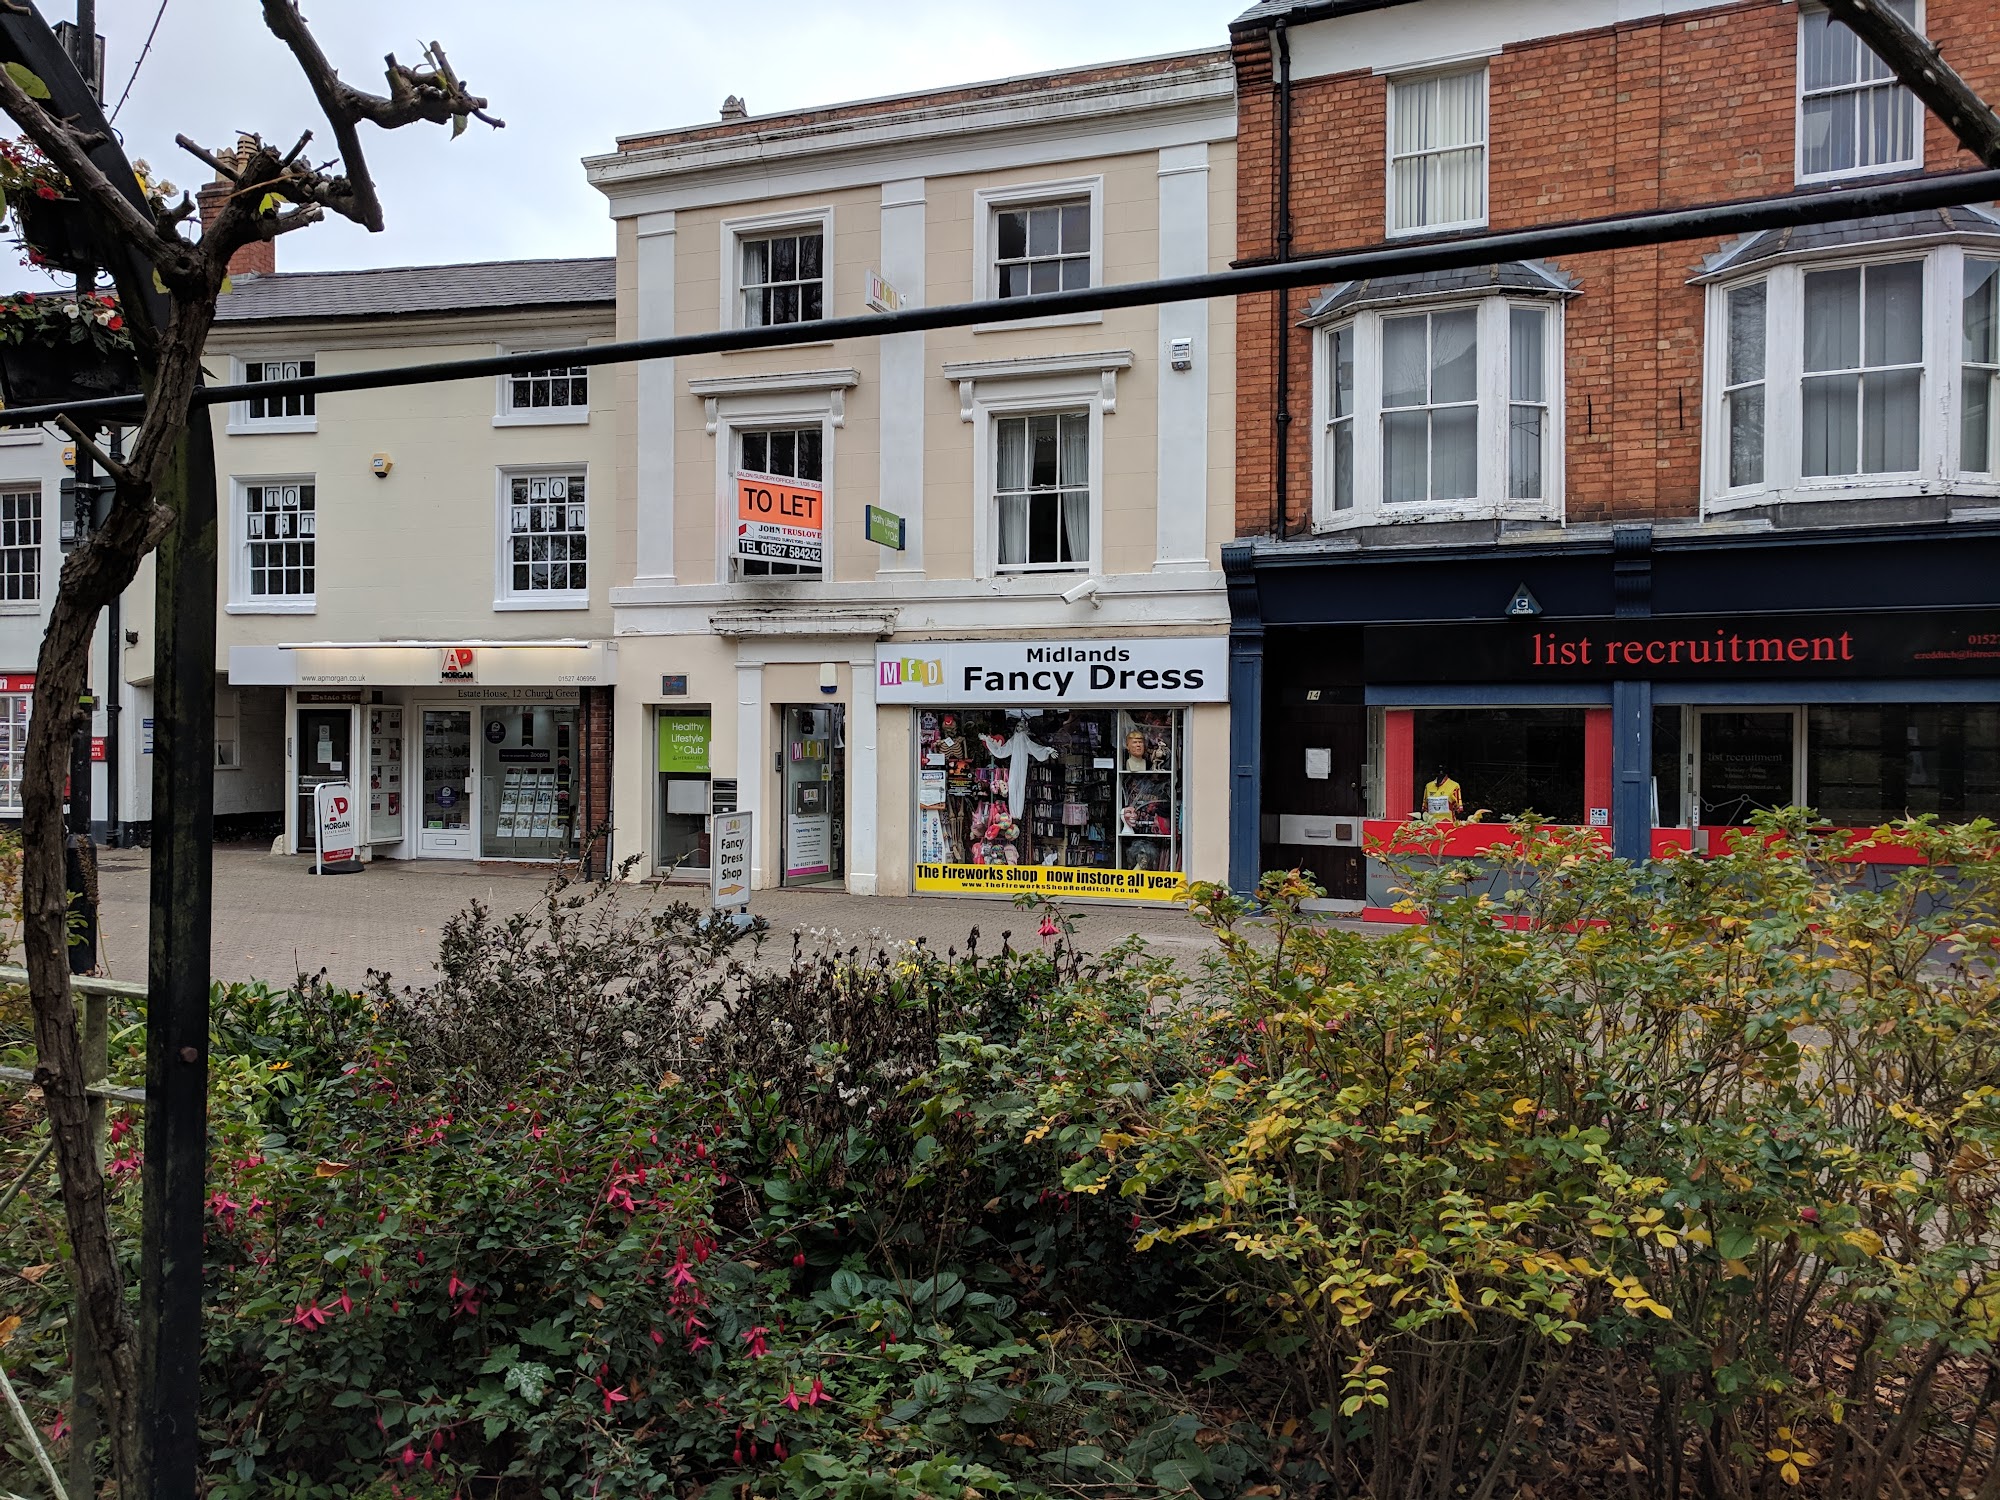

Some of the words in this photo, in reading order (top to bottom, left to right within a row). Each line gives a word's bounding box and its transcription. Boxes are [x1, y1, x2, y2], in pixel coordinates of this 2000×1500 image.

[534, 481, 564, 497] TO
[268, 489, 297, 506] TO
[744, 488, 772, 512] TO
[780, 493, 817, 518] LET
[252, 518, 315, 534] LET
[516, 510, 583, 528] LET
[758, 525, 780, 534] JOHN
[782, 527, 822, 539] TRUSLOVE
[740, 540, 759, 554] TEL
[761, 542, 787, 557] 01527
[789, 546, 820, 560] 584242
[1027, 646, 1130, 662] Midlands
[1532, 633, 1592, 665] list
[1605, 629, 1854, 664] recruitment
[442, 649, 473, 670] AP
[302, 674, 366, 683] www.apmorgan.co.uk
[882, 659, 941, 686] MFD
[964, 666, 1074, 697] Fancy
[1090, 664, 1205, 690] Dress
[458, 689, 481, 698] Estate
[483, 689, 510, 699] House,
[512, 689, 522, 698] 12
[525, 688, 553, 698] Church
[556, 688, 579, 698] Green
[1308, 691, 1319, 700] 14
[672, 722, 705, 732] Healthy
[671, 733, 704, 744] Lifestyle
[683, 745, 704, 755] Club
[793, 740, 824, 760] MFD
[1726, 753, 1783, 762] recruitment
[324, 797, 349, 822] AP
[324, 820, 350, 831] MORGAN
[721, 838, 744, 850] Fancy
[721, 853, 743, 865] Dress
[721, 867, 742, 881] Shop
[917, 865, 939, 879] The
[942, 866, 1004, 881] Fireworks
[1006, 867, 1038, 883] shop
[1046, 870, 1074, 882] now
[1076, 870, 1125, 886] instore
[1127, 873, 1145, 887] all
[1147, 875, 1179, 889] year
[961, 882, 1140, 894] www.TheFireworksShopRedditch.co.uk
